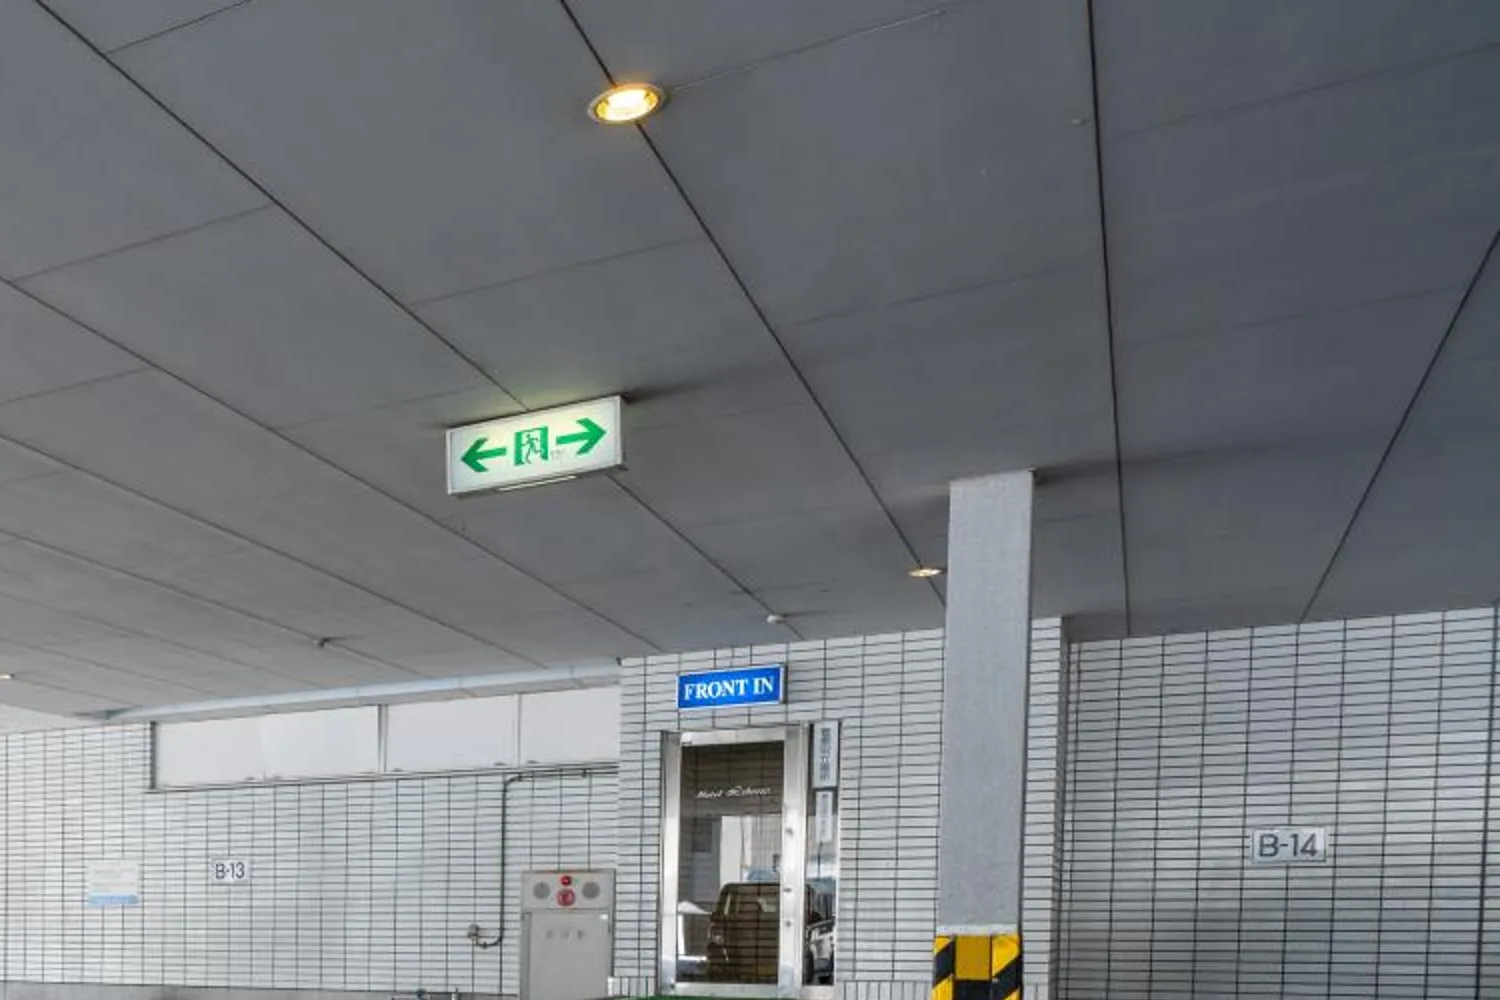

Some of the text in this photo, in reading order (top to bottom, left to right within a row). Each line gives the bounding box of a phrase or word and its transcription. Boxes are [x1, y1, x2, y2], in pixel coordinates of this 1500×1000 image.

[684, 676, 774, 700] FRONT IN
[1259, 833, 1318, 857] B-14
[215, 861, 245, 880] B-13
